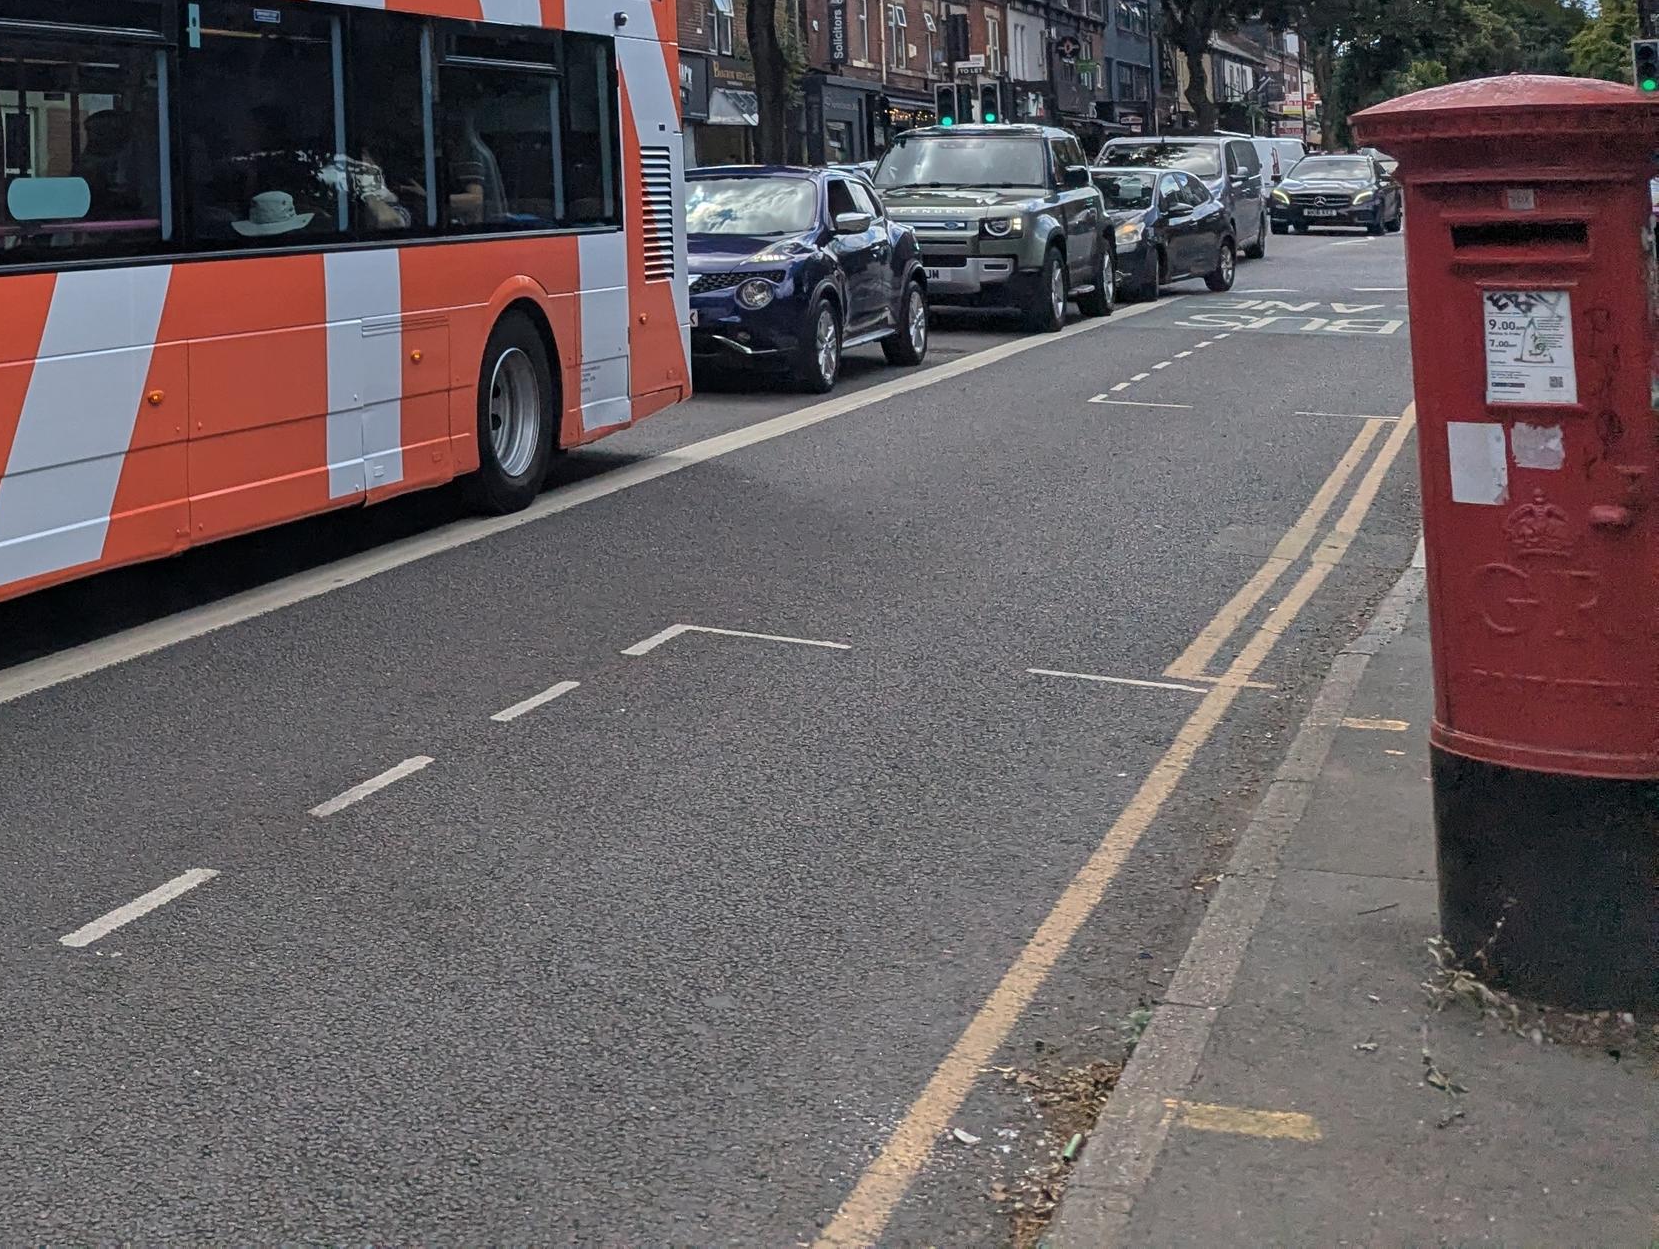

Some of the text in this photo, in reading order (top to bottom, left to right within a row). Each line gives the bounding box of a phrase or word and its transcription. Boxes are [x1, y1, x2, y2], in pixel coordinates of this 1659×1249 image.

[833, 8, 844, 60] Solicitors
[1185, 300, 1408, 314] ANE
[1173, 313, 1404, 334] BUS
